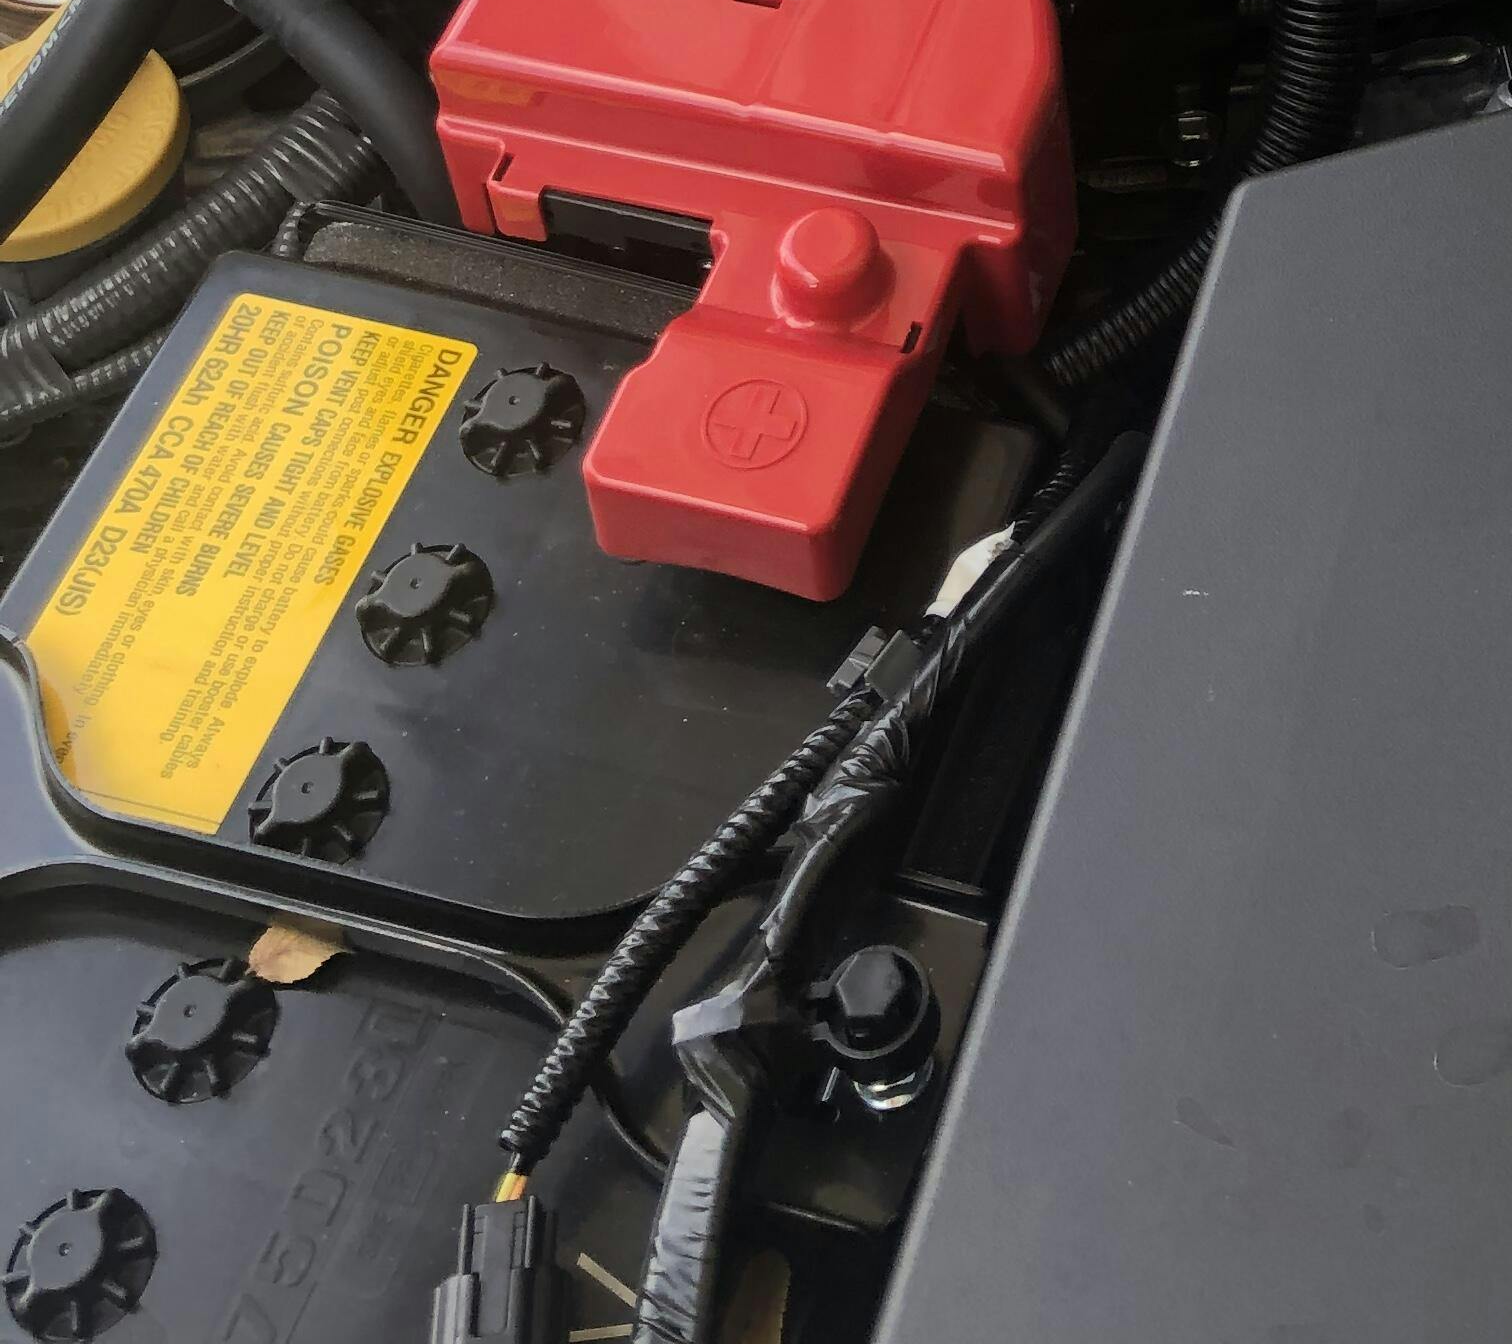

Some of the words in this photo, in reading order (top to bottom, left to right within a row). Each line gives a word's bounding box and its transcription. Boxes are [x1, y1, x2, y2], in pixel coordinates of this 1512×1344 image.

[211, 302, 264, 356] 20HR
[254, 309, 291, 346] KEEP
[290, 314, 310, 328] of
[235, 347, 269, 377] OUT
[260, 330, 300, 378] accident
[283, 318, 325, 369] Contains
[345, 330, 383, 367] KEEP
[384, 336, 401, 349] or
[387, 339, 419, 374] shield
[179, 356, 231, 408] 62Ah
[279, 322, 355, 417] POISON
[360, 350, 394, 385] adjust
[221, 379, 250, 400] OF
[241, 381, 270, 411] flush
[256, 369, 295, 415] sulfuric
[323, 368, 362, 407] VENT
[344, 387, 373, 414] post
[367, 375, 397, 404] eyes
[389, 348, 465, 446] DANGER
[190, 401, 236, 451] REACH
[223, 412, 251, 441] with
[299, 408, 339, 448] CAPS
[356, 406, 381, 429] and
[363, 409, 397, 450] flames
[145, 413, 196, 464] CCA
[241, 421, 293, 481] CAUSES
[304, 416, 358, 487] connections
[340, 431, 367, 458] face
[177, 452, 205, 474] OF
[199, 444, 231, 481] water
[216, 447, 249, 483] Avoid
[271, 448, 315, 495] TIGHT
[321, 460, 351, 491] from
[354, 451, 371, 466] or
[113, 462, 166, 518] 470A
[183, 484, 208, 508] and
[328, 466, 365, 509] sparks
[341, 450, 404, 531] EXPLOSIVE
[128, 475, 192, 554] CHILDREN
[168, 509, 194, 533] call
[187, 485, 226, 531] contact
[206, 482, 257, 540] SEVERE
[251, 495, 288, 531] AND
[275, 489, 316, 538] without
[310, 510, 342, 545] could
[167, 534, 197, 565] with
[221, 531, 268, 582] LEVEL
[248, 539, 287, 584] proper
[282, 543, 304, 562] Do
[288, 547, 318, 584] cause
[310, 533, 358, 587] GASES
[51, 524, 130, 619] D23(JIS)
[120, 546, 171, 609] physician
[172, 542, 222, 598] BURNS
[267, 562, 292, 586] not
[126, 598, 157, 632] eyes
[207, 585, 262, 658] instruction
[239, 586, 279, 633] charge
[257, 585, 299, 636] battery
[117, 633, 137, 650] or
[231, 634, 251, 651] or
[249, 638, 269, 653] to
[192, 659, 219, 686] and
[216, 652, 241, 677] use
[185, 679, 228, 731] booster
[158, 733, 197, 780] cables
[181, 715, 227, 770] Always
